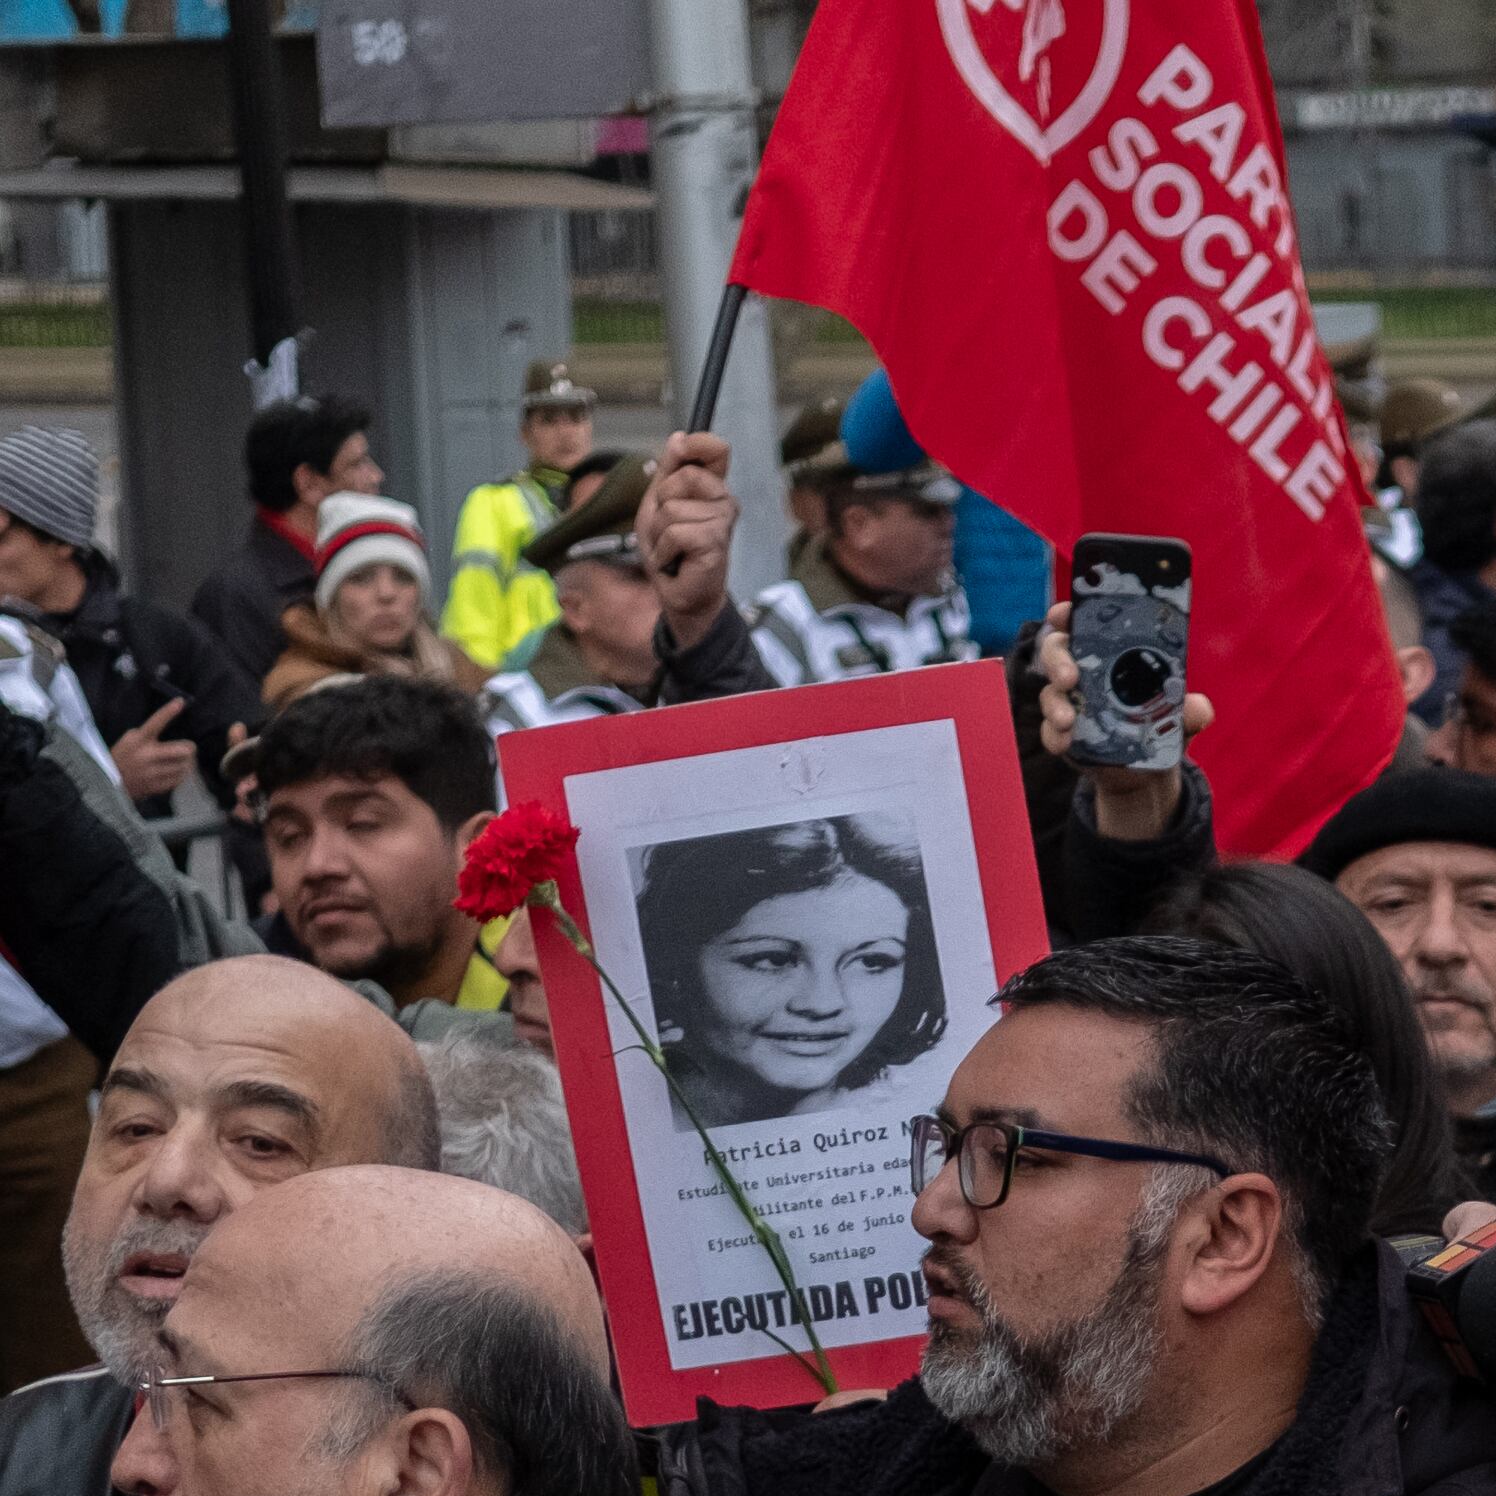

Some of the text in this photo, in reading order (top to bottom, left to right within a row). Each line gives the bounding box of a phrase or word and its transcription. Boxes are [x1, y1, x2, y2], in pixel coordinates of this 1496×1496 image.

[1047, 179, 1346, 523] DE CHILE
[813, 1125, 889, 1151] Quiroz
[766, 1164, 875, 1188] Universitaria
[831, 1192, 855, 1206] del
[788, 1226, 804, 1240] el
[813, 1223, 830, 1236] 16
[837, 1220, 855, 1234] de
[863, 1213, 905, 1232] junio
[808, 1245, 876, 1265] Santiago
[672, 1280, 860, 1341] EJECUTADA
